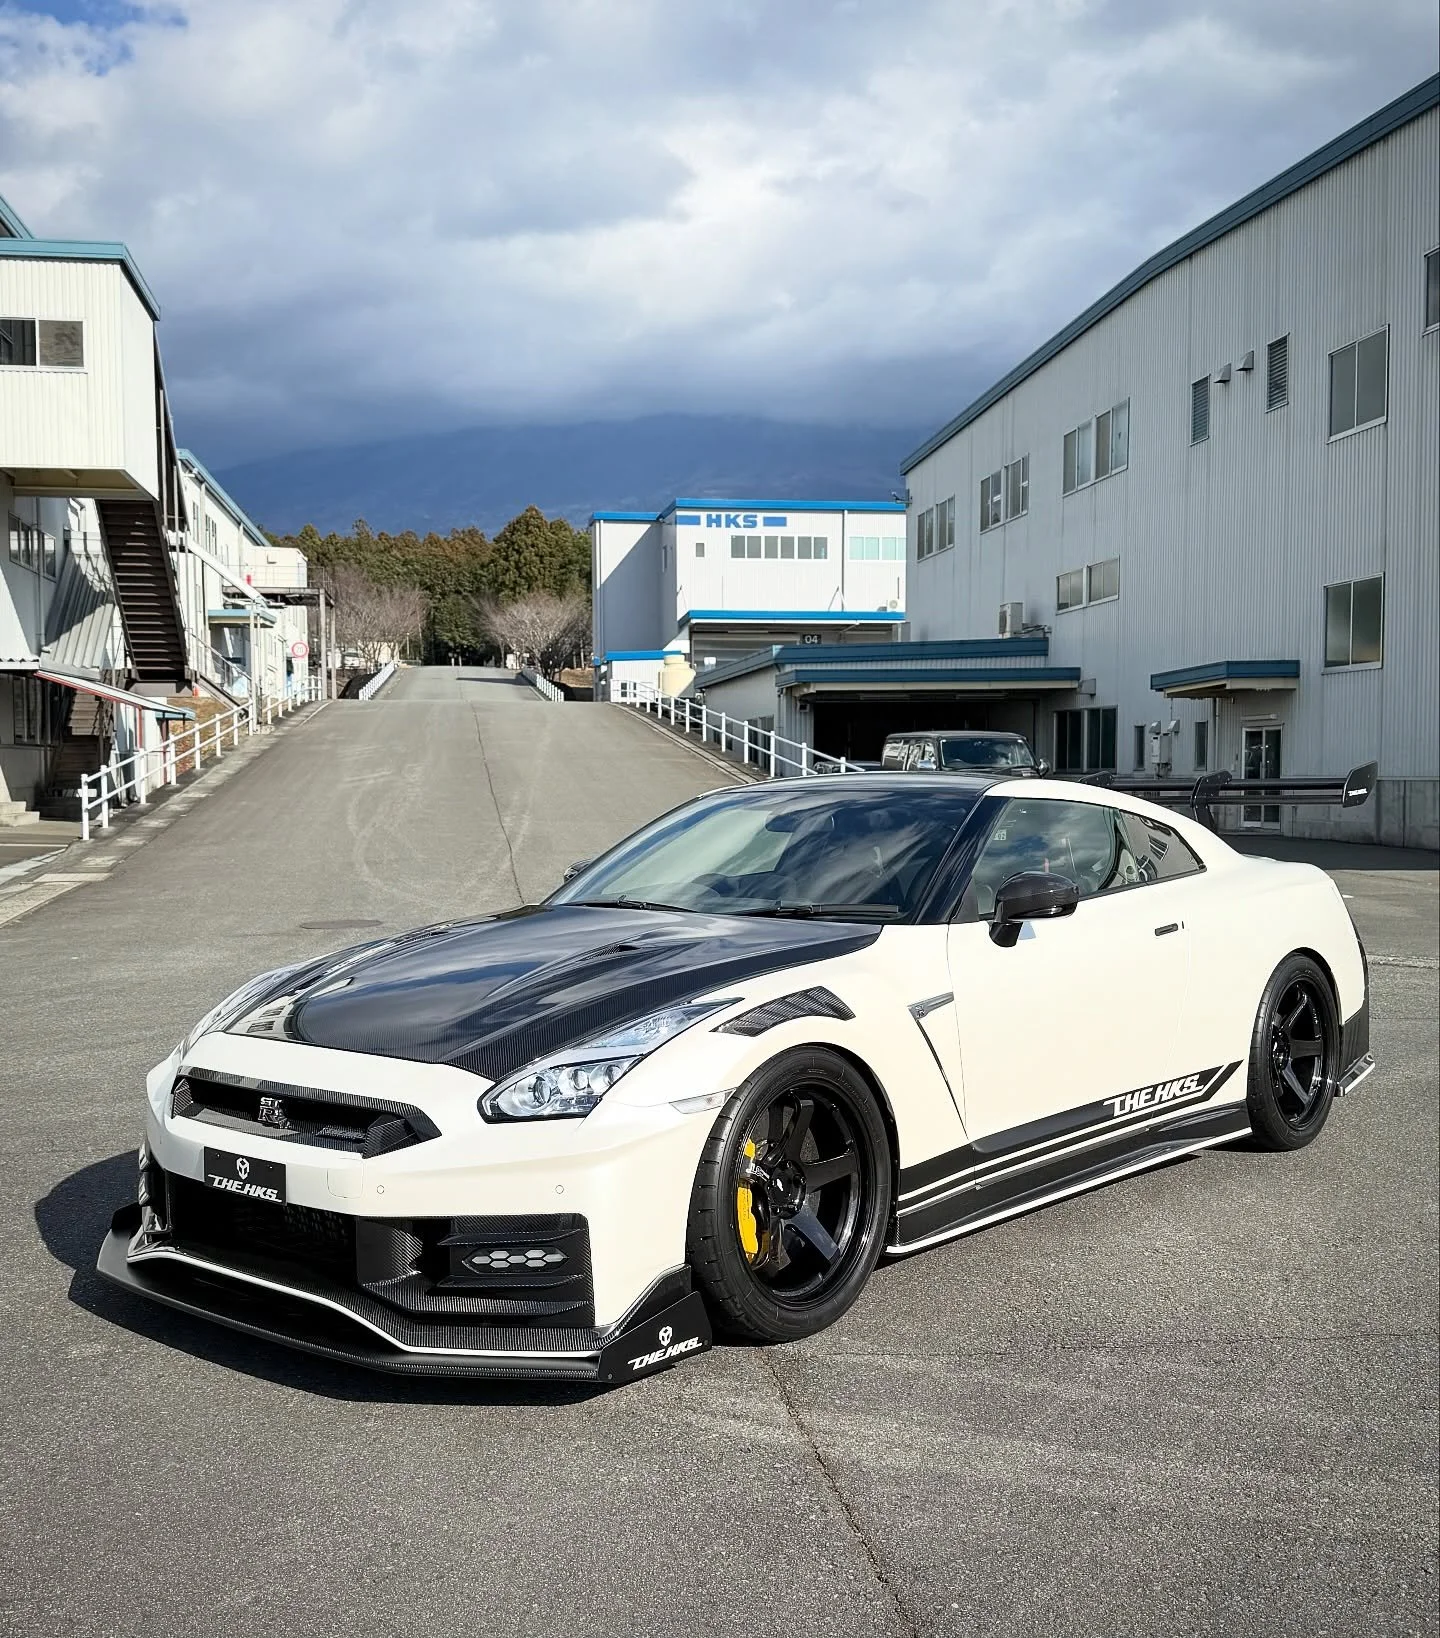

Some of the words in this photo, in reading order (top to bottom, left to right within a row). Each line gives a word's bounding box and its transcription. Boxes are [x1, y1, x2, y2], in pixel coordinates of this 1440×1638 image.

[706, 513, 758, 529] HKS
[804, 635, 818, 644] 04
[1154, 1074, 1204, 1102] HKS
[243, 1183, 282, 1202] HKS
